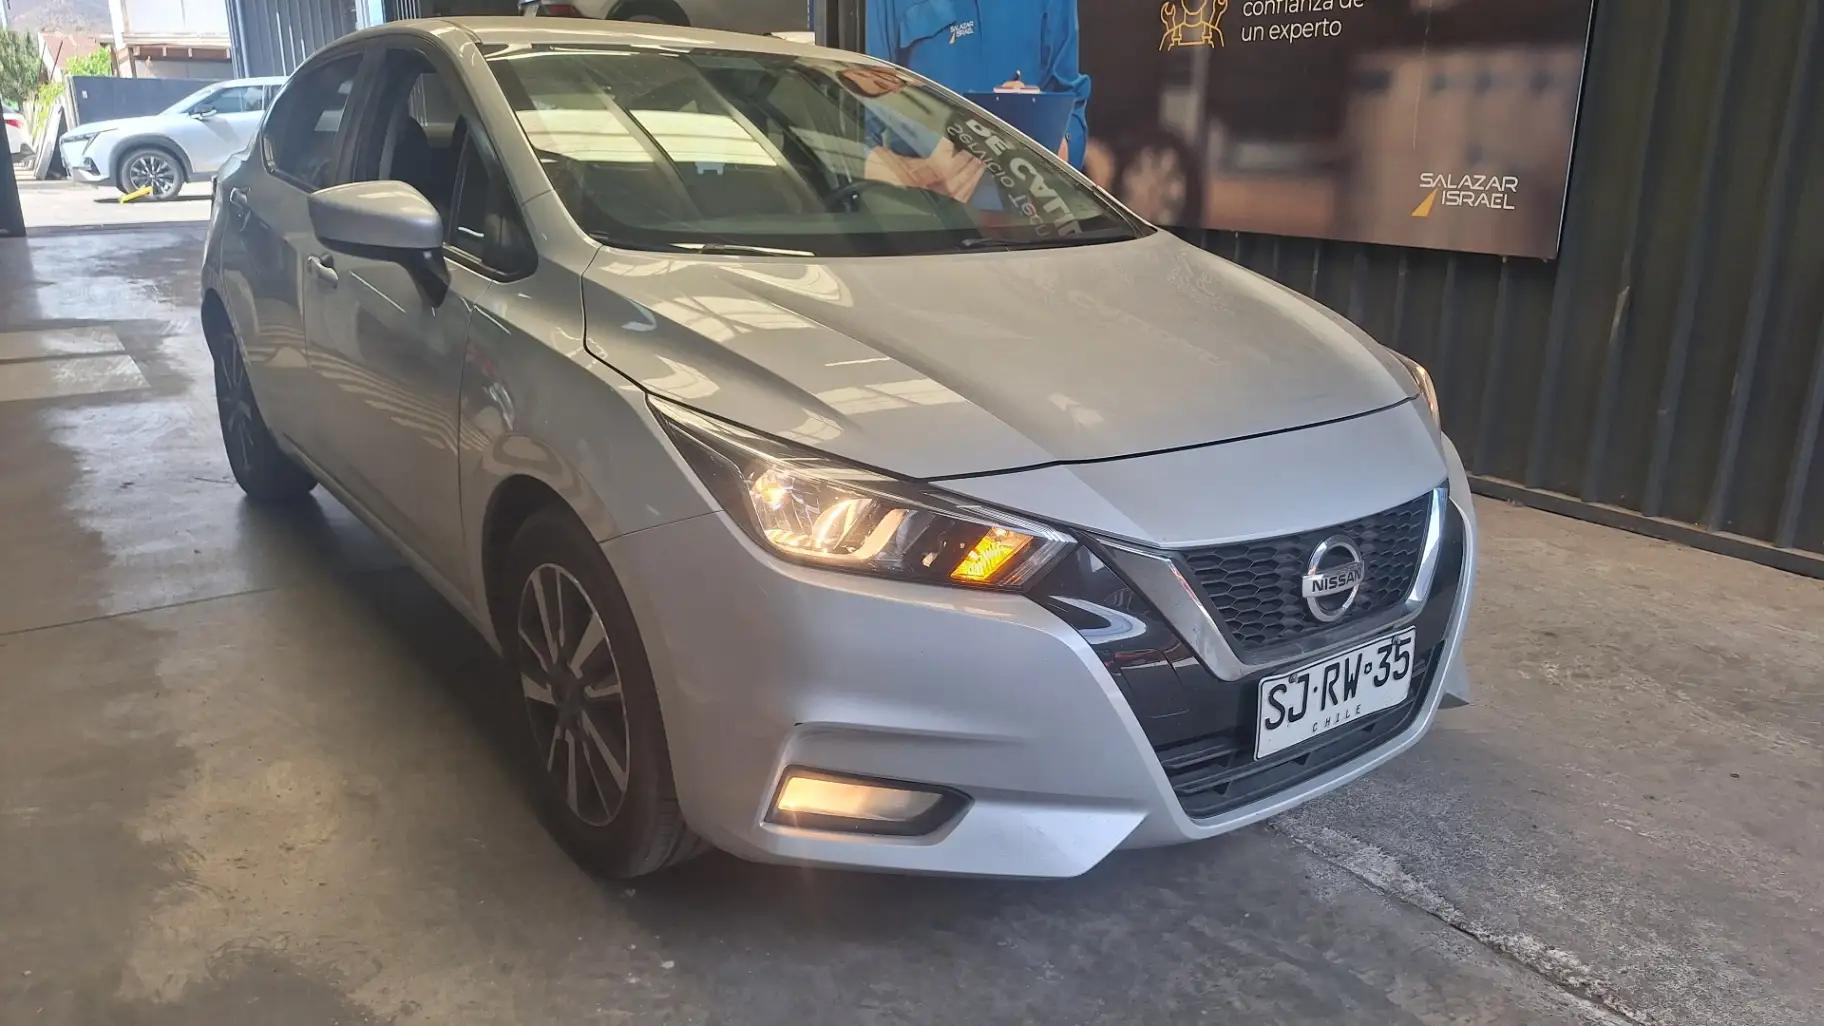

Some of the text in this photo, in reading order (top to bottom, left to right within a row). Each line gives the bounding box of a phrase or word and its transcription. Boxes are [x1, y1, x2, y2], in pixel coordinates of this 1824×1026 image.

[1242, 0, 1334, 16] confianza
[1241, 18, 1342, 43] un experto
[1419, 172, 1519, 192] SALAZAR
[1441, 190, 1515, 209] ISRAEL
[1312, 569, 1362, 592] NISSAN
[1312, 703, 1362, 732] CHILE
